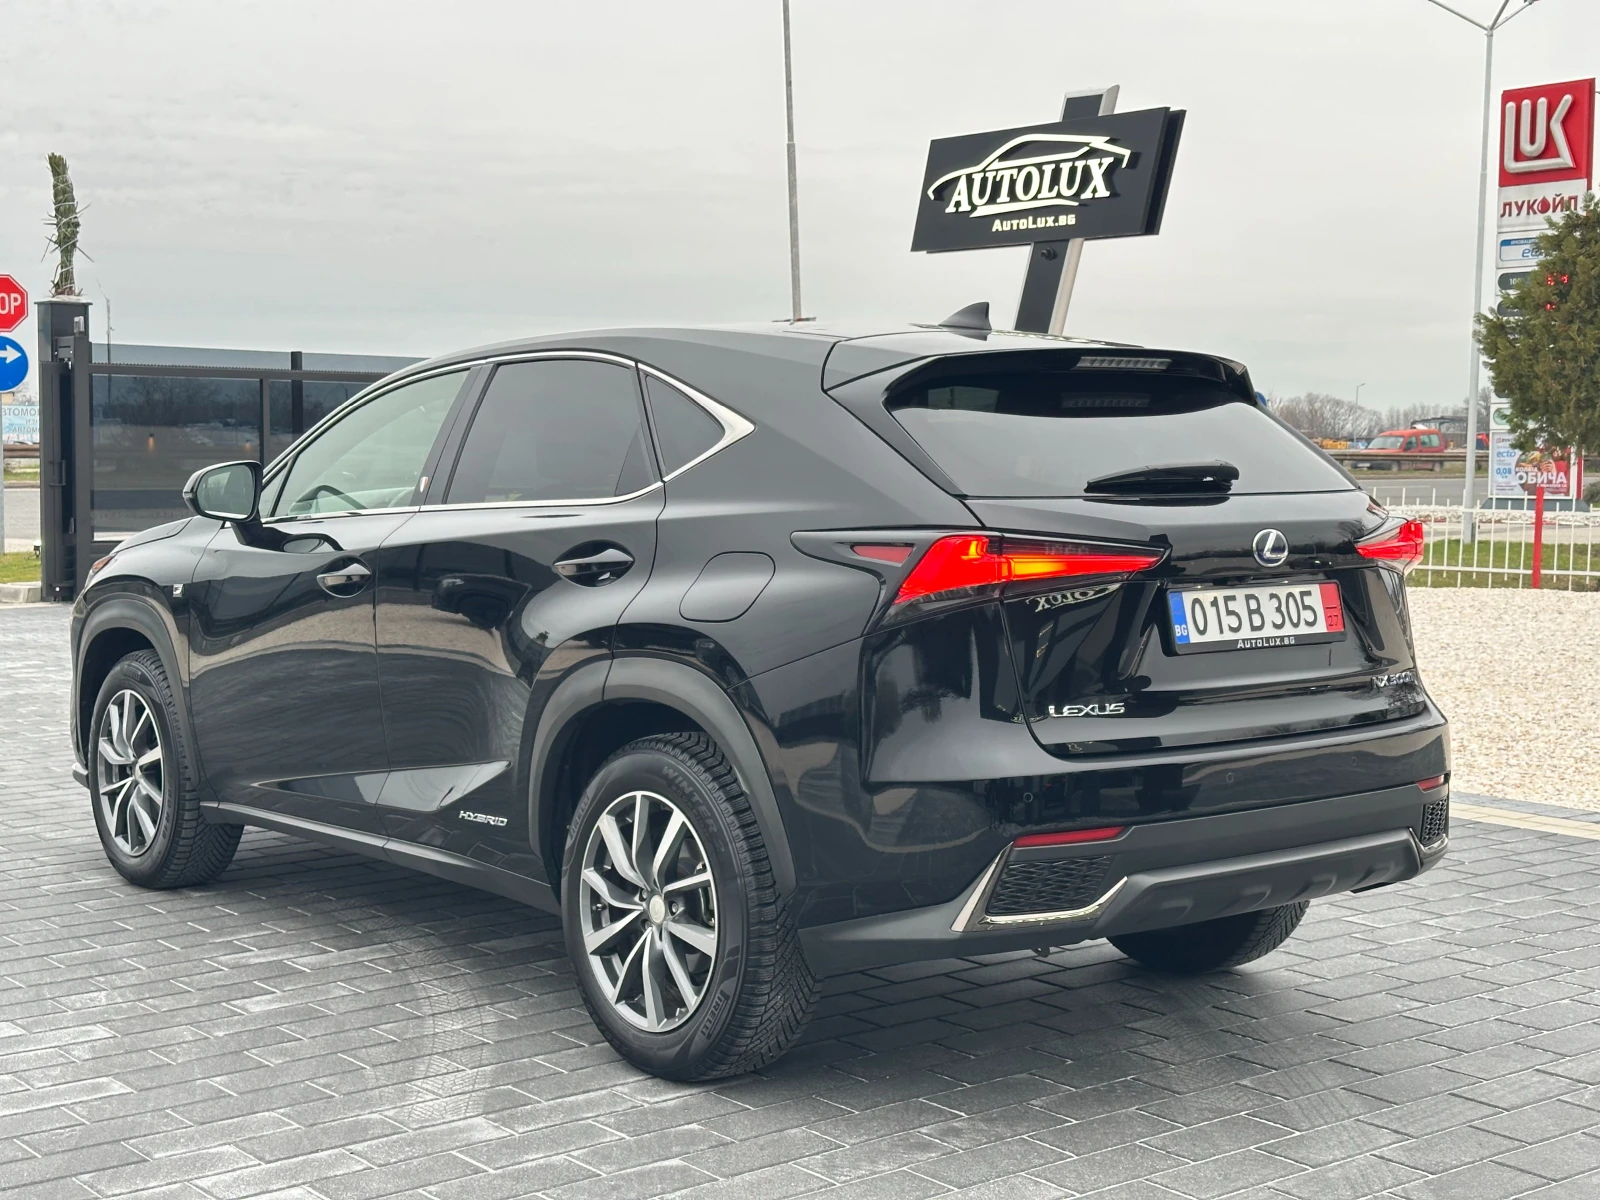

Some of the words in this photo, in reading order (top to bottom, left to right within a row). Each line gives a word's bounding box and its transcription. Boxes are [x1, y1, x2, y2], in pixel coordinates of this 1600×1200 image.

[945, 156, 1114, 213] AUTOLUX
[0, 292, 22, 315] OP
[2, 407, 39, 417] ВТОМО
[1517, 472, 1567, 484] ОБИЧА
[1327, 614, 1339, 627] 27
[1175, 624, 1188, 637] BG
[1048, 702, 1125, 717] LEXUS
[661, 764, 718, 833] WINTER
[459, 810, 508, 827] HYBRID
